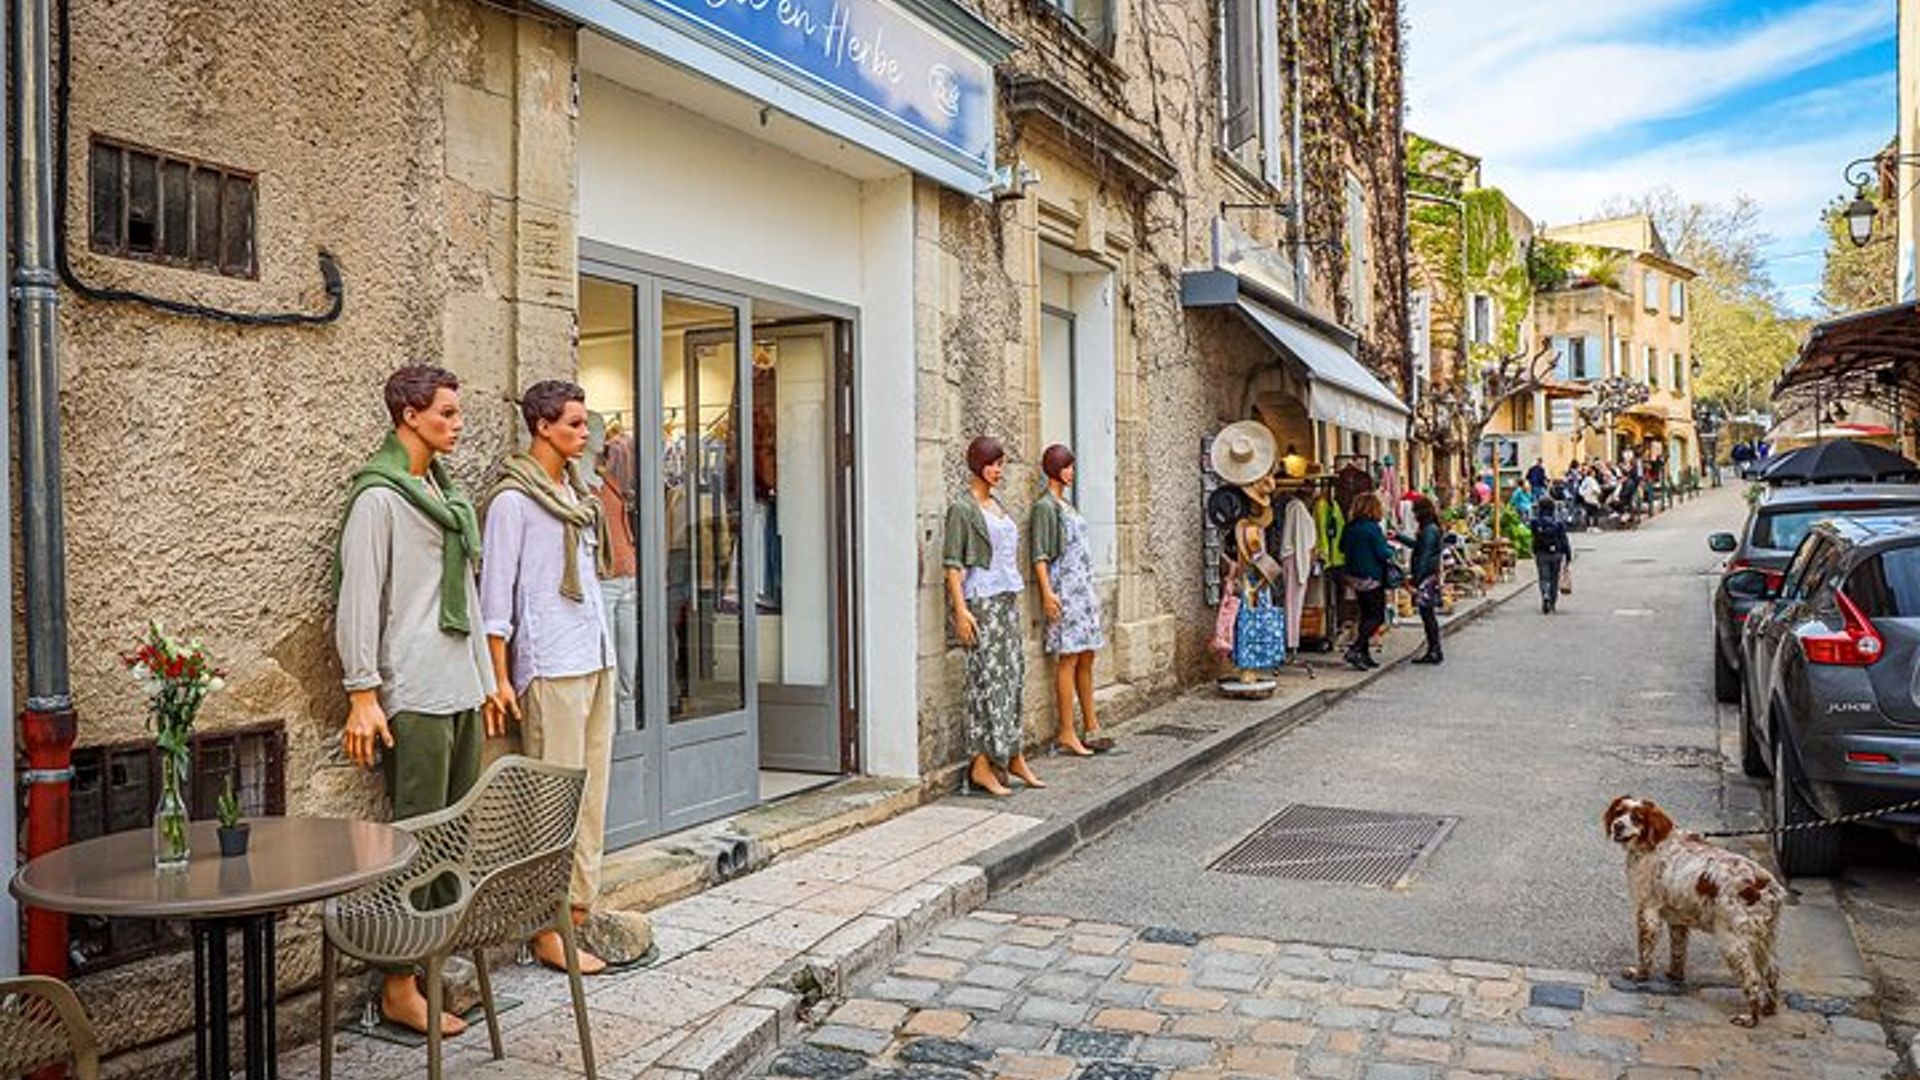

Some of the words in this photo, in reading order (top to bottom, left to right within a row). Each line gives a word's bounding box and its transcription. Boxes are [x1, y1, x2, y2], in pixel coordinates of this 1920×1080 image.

[776, 0, 816, 35] en
[822, 0, 904, 83] Herbe
[1824, 702, 1872, 715] JUKE
